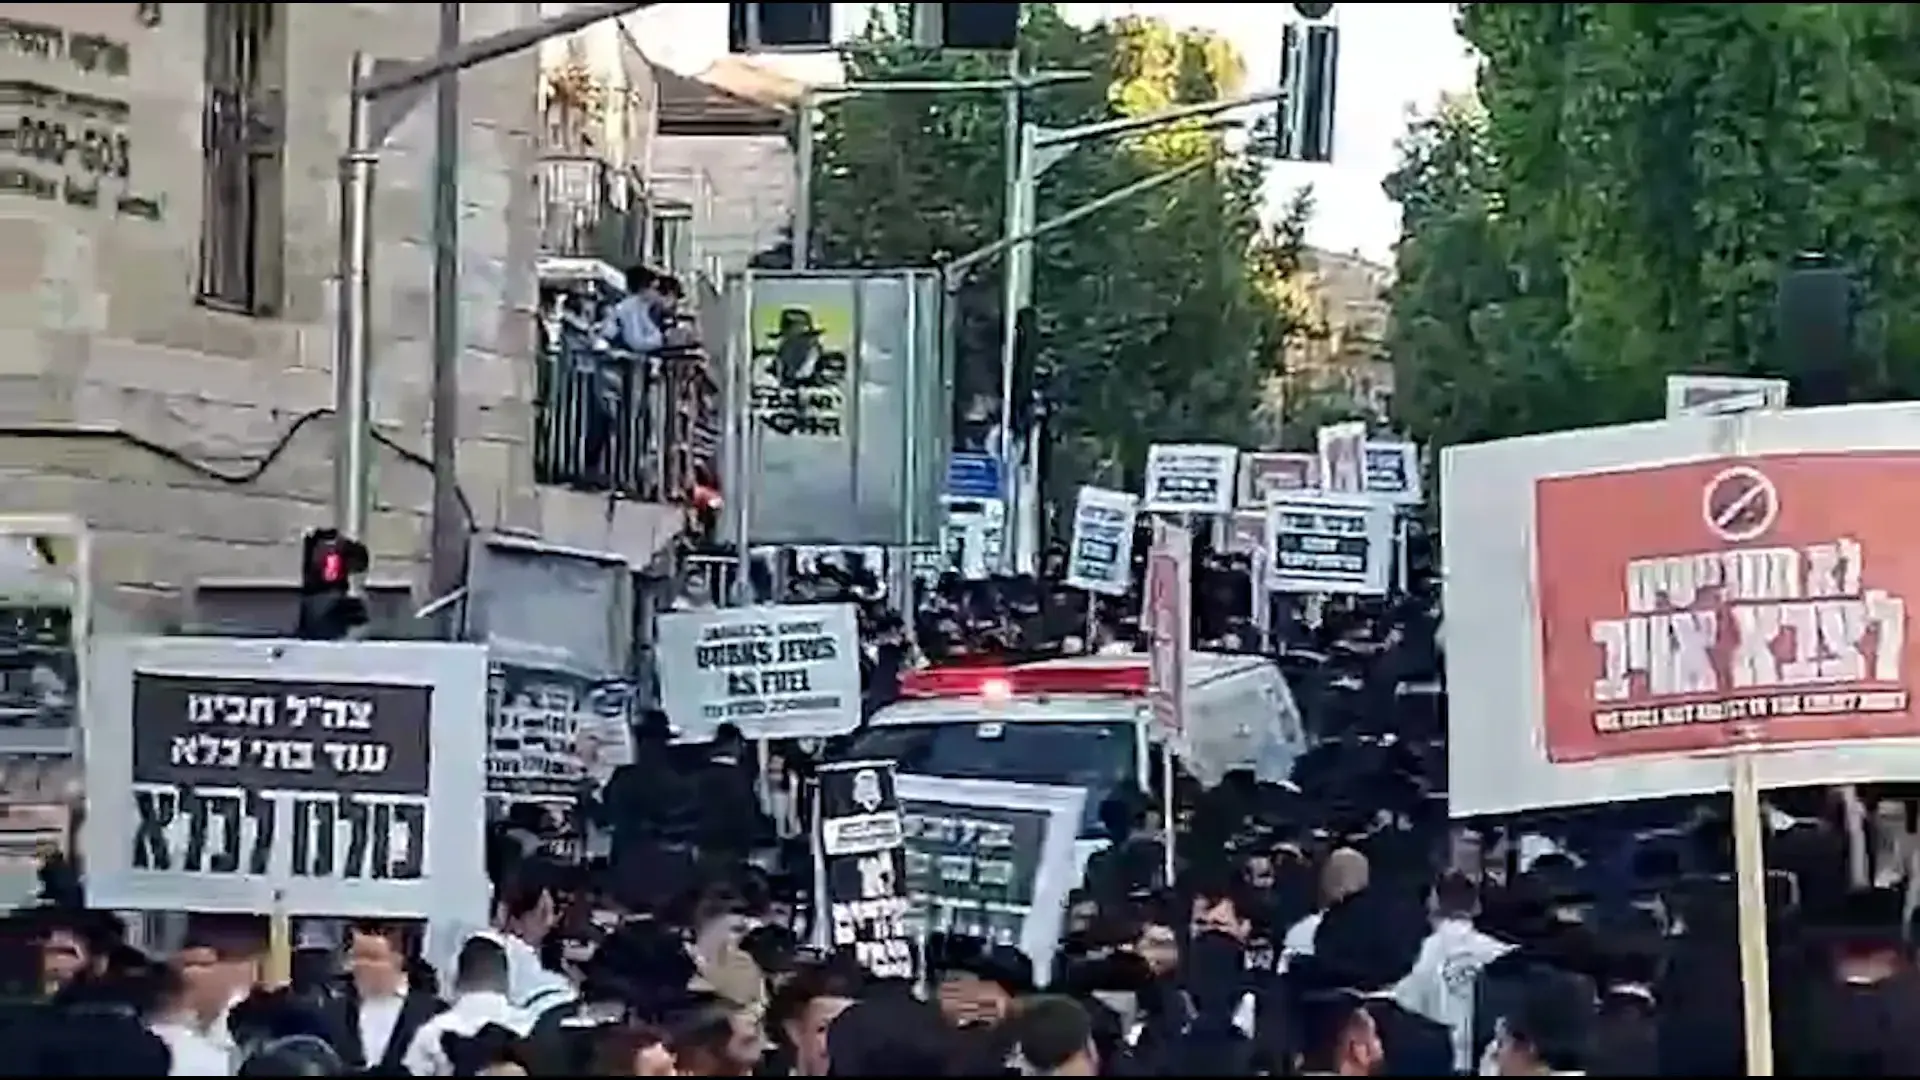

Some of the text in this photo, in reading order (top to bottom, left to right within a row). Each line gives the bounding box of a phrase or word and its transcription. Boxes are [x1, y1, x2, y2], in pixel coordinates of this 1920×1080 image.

[1806, 538, 1862, 597] לא
[778, 638, 836, 662] JEWS
[1590, 590, 1905, 701] לצבא אויב
[728, 670, 810, 695] AS FUEL
[189, 692, 276, 726] תכינו
[171, 733, 390, 773] עוד בתי כלא
[133, 788, 276, 874] לכלא
